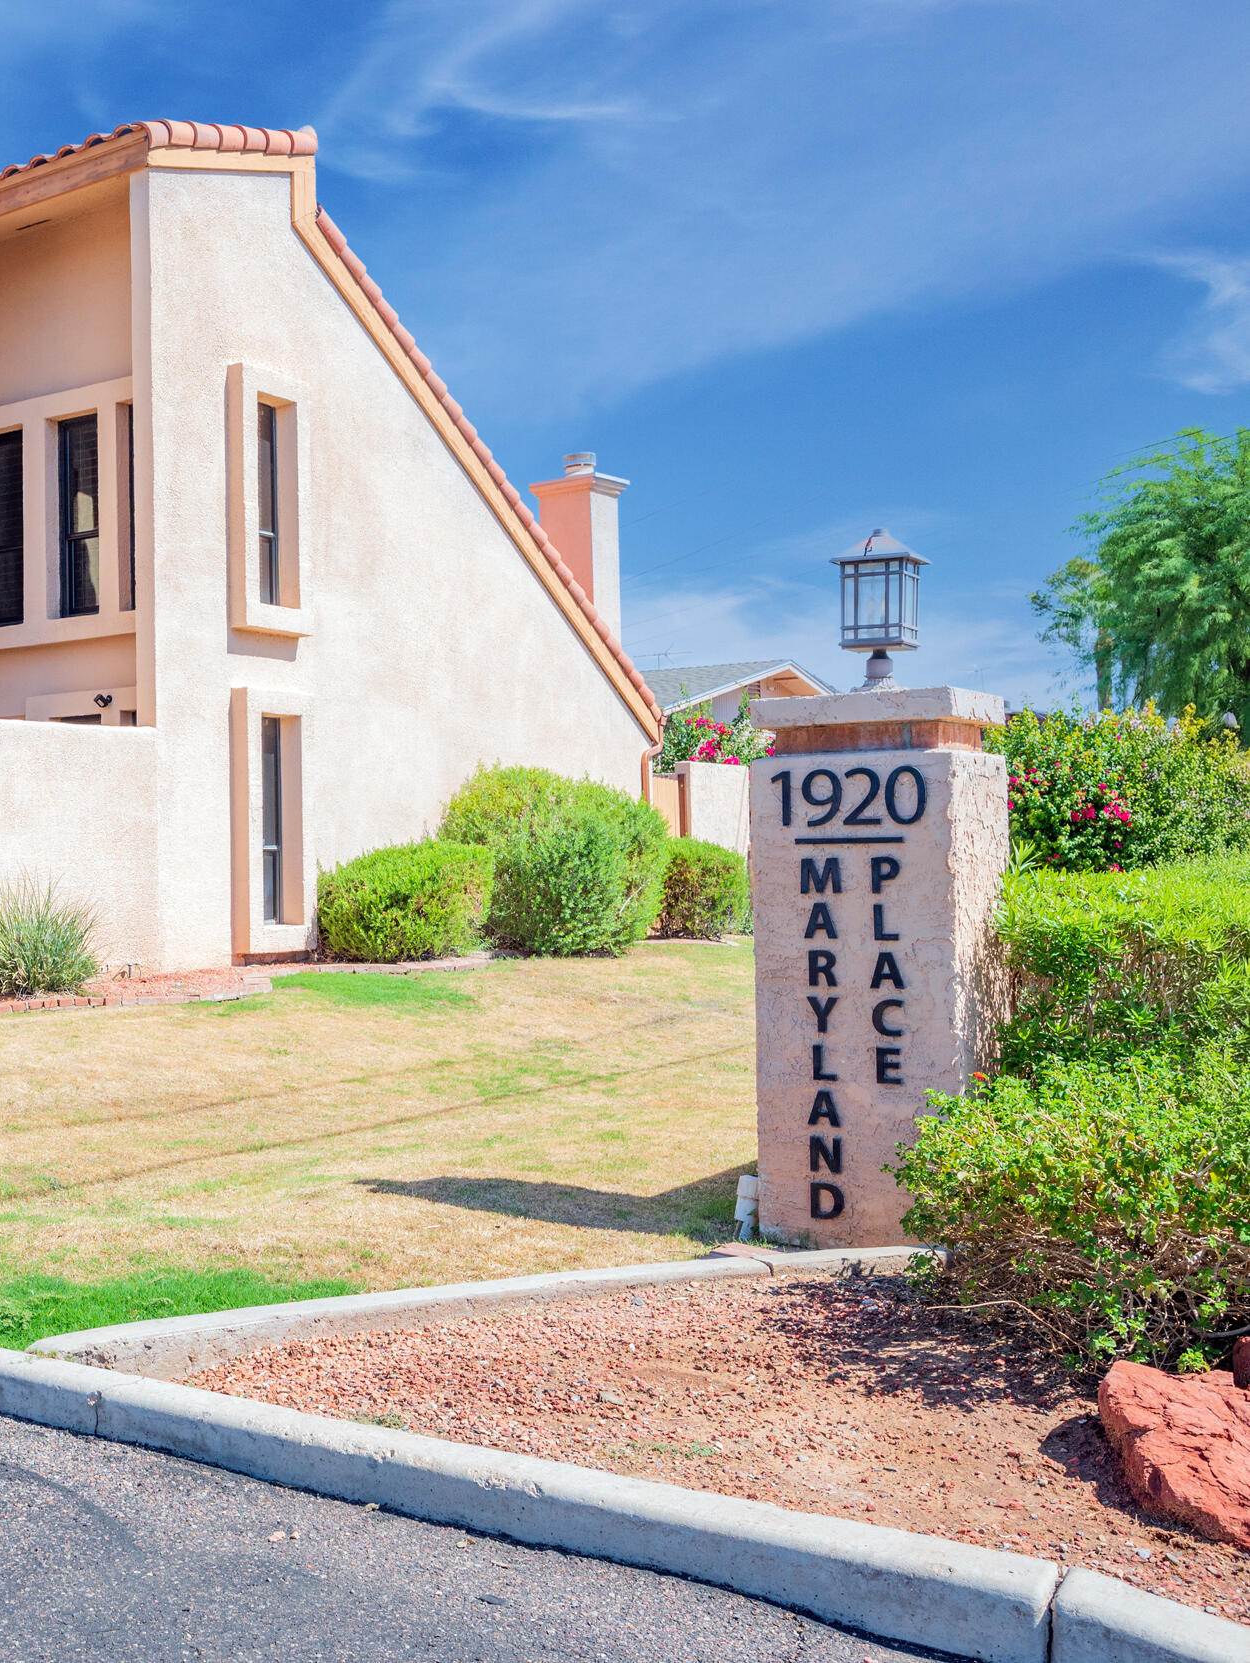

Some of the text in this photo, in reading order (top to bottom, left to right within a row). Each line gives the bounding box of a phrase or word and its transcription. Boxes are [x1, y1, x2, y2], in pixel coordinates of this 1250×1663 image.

[770, 766, 928, 827] 1920
[800, 857, 845, 1220] MARYLAND
[870, 857, 905, 1085] PLACE
